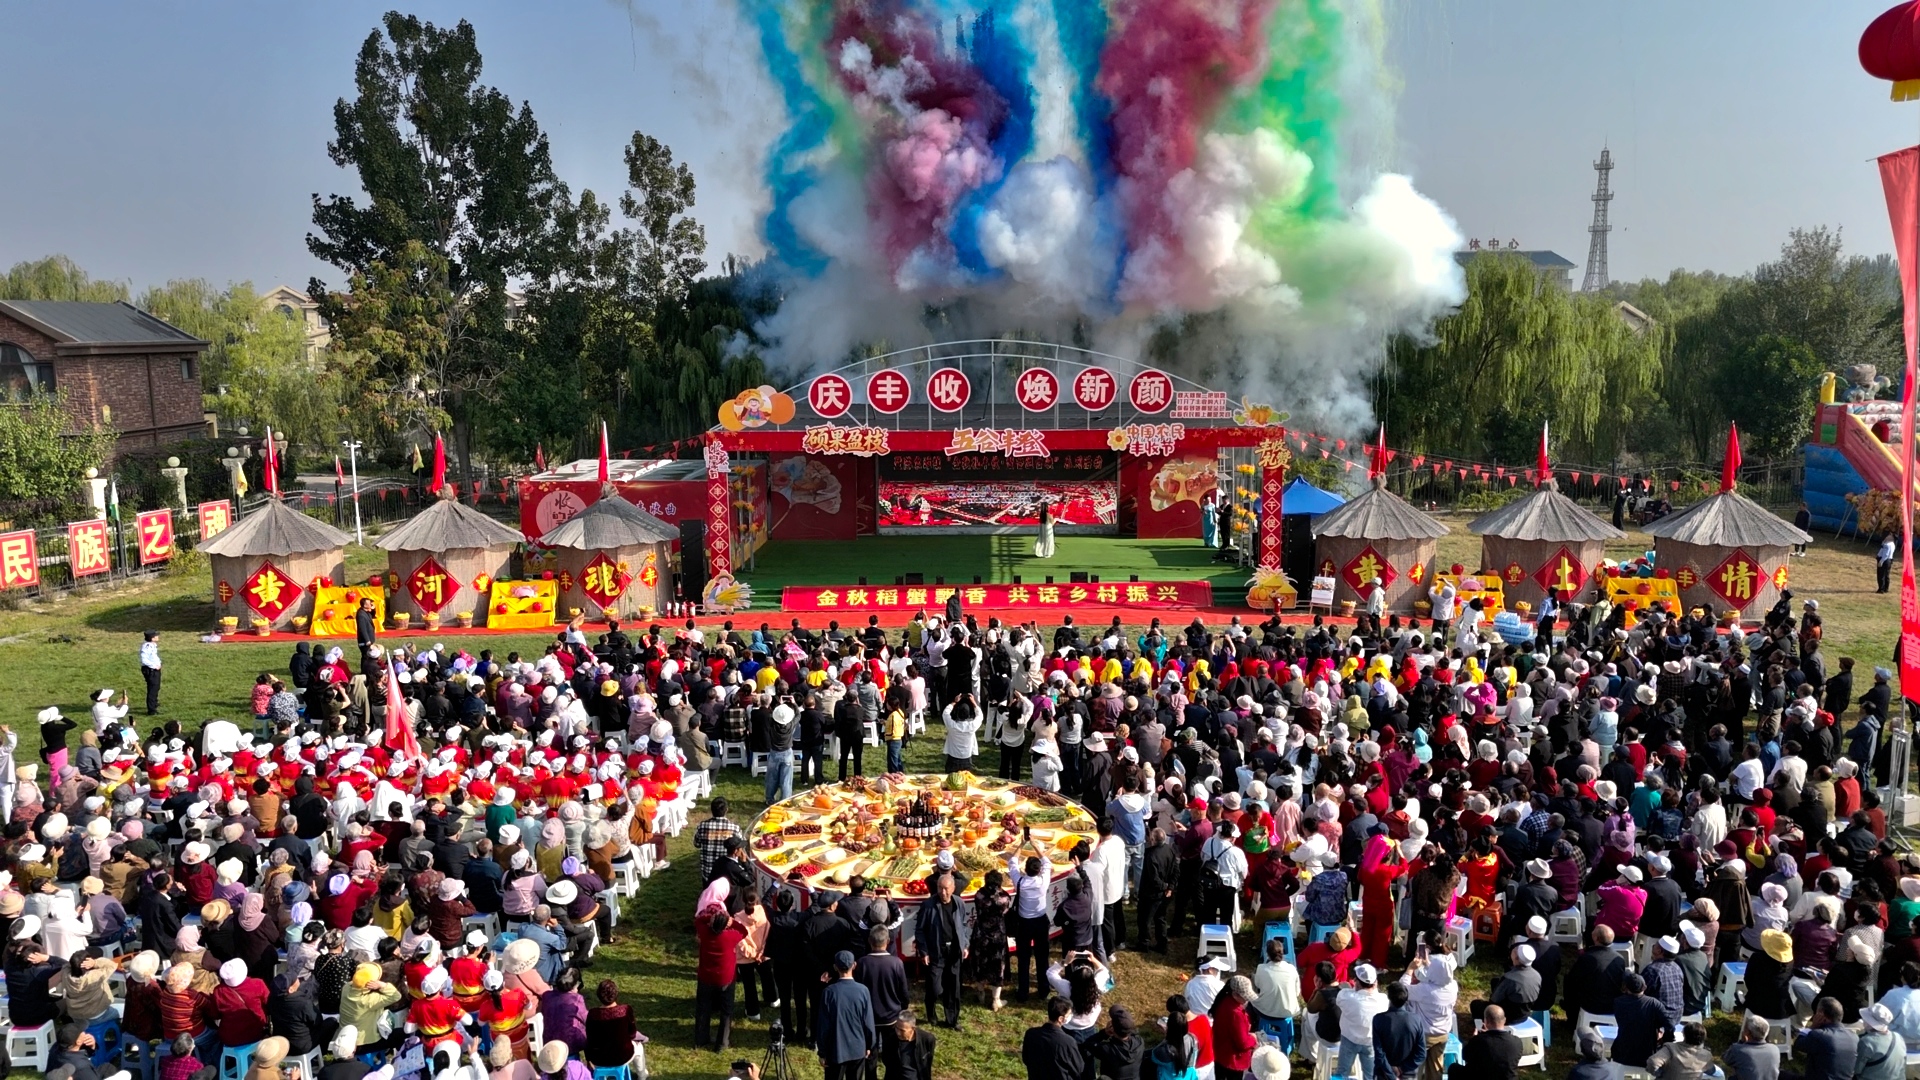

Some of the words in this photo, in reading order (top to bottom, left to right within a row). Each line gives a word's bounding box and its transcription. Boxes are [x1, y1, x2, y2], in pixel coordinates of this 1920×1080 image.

[806, 427, 889, 455] 硕果盈枝
[945, 428, 1050, 457] 五谷丰登
[1126, 424, 1185, 439] 中国农民
[1130, 440, 1175, 455] 丰收节
[1254, 438, 1288, 458] 丰收
[144, 517, 169, 556] 之
[204, 506, 227, 538] 魂
[713, 487, 725, 567] 丰收开新局
[1, 538, 33, 583] 民
[75, 527, 105, 569] 族
[561, 573, 572, 590] 丰
[585, 561, 620, 597] 魂
[643, 567, 658, 586] 丰
[1352, 554, 1384, 588] 黄
[1552, 555, 1577, 590] 土
[1678, 569, 1694, 587] 丰
[1721, 561, 1758, 600] 情
[219, 583, 232, 601] 丰
[250, 570, 286, 610] 黄
[416, 572, 447, 605] 河
[1008, 585, 1179, 604] 共话乡村振兴
